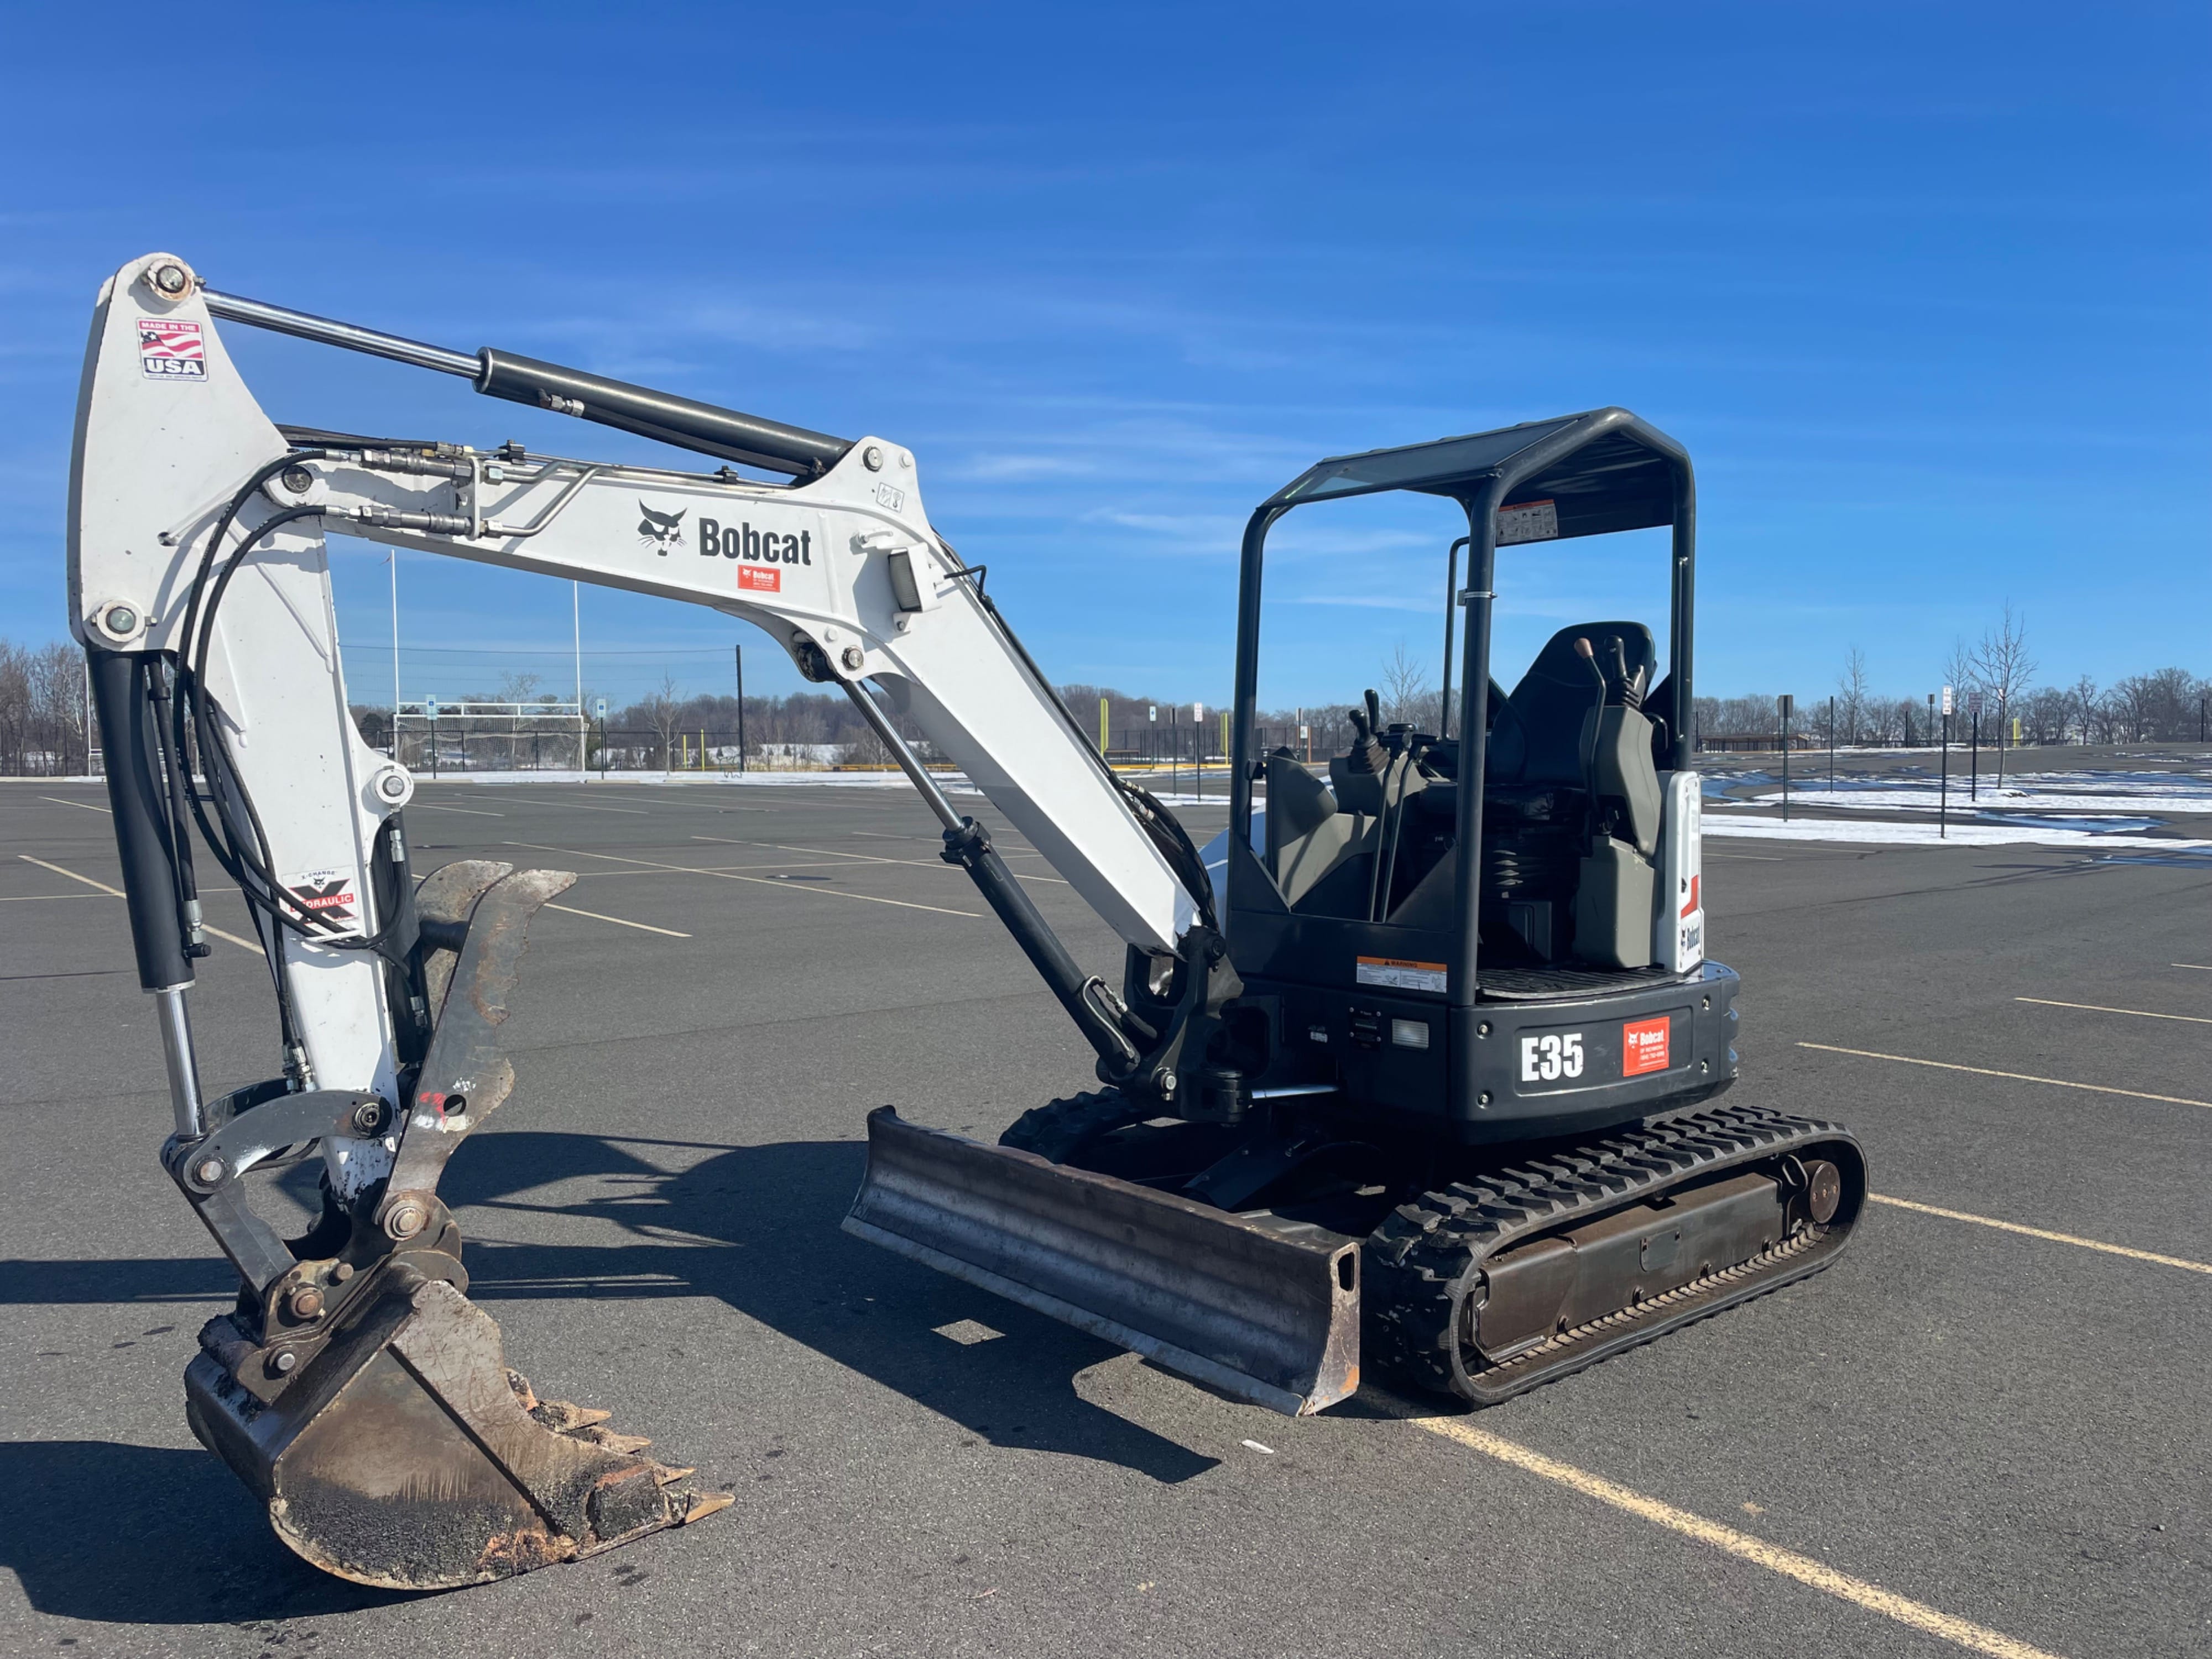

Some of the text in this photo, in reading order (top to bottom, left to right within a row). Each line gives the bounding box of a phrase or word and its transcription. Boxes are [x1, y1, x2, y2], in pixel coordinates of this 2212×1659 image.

[146, 359, 202, 374] USA
[699, 518, 811, 566] Bobcat
[753, 570, 774, 580] Bobcat
[1687, 922, 1700, 951] Bobcat
[1640, 1029, 1664, 1046] Bobcat
[1522, 1033, 1584, 1081] E35
